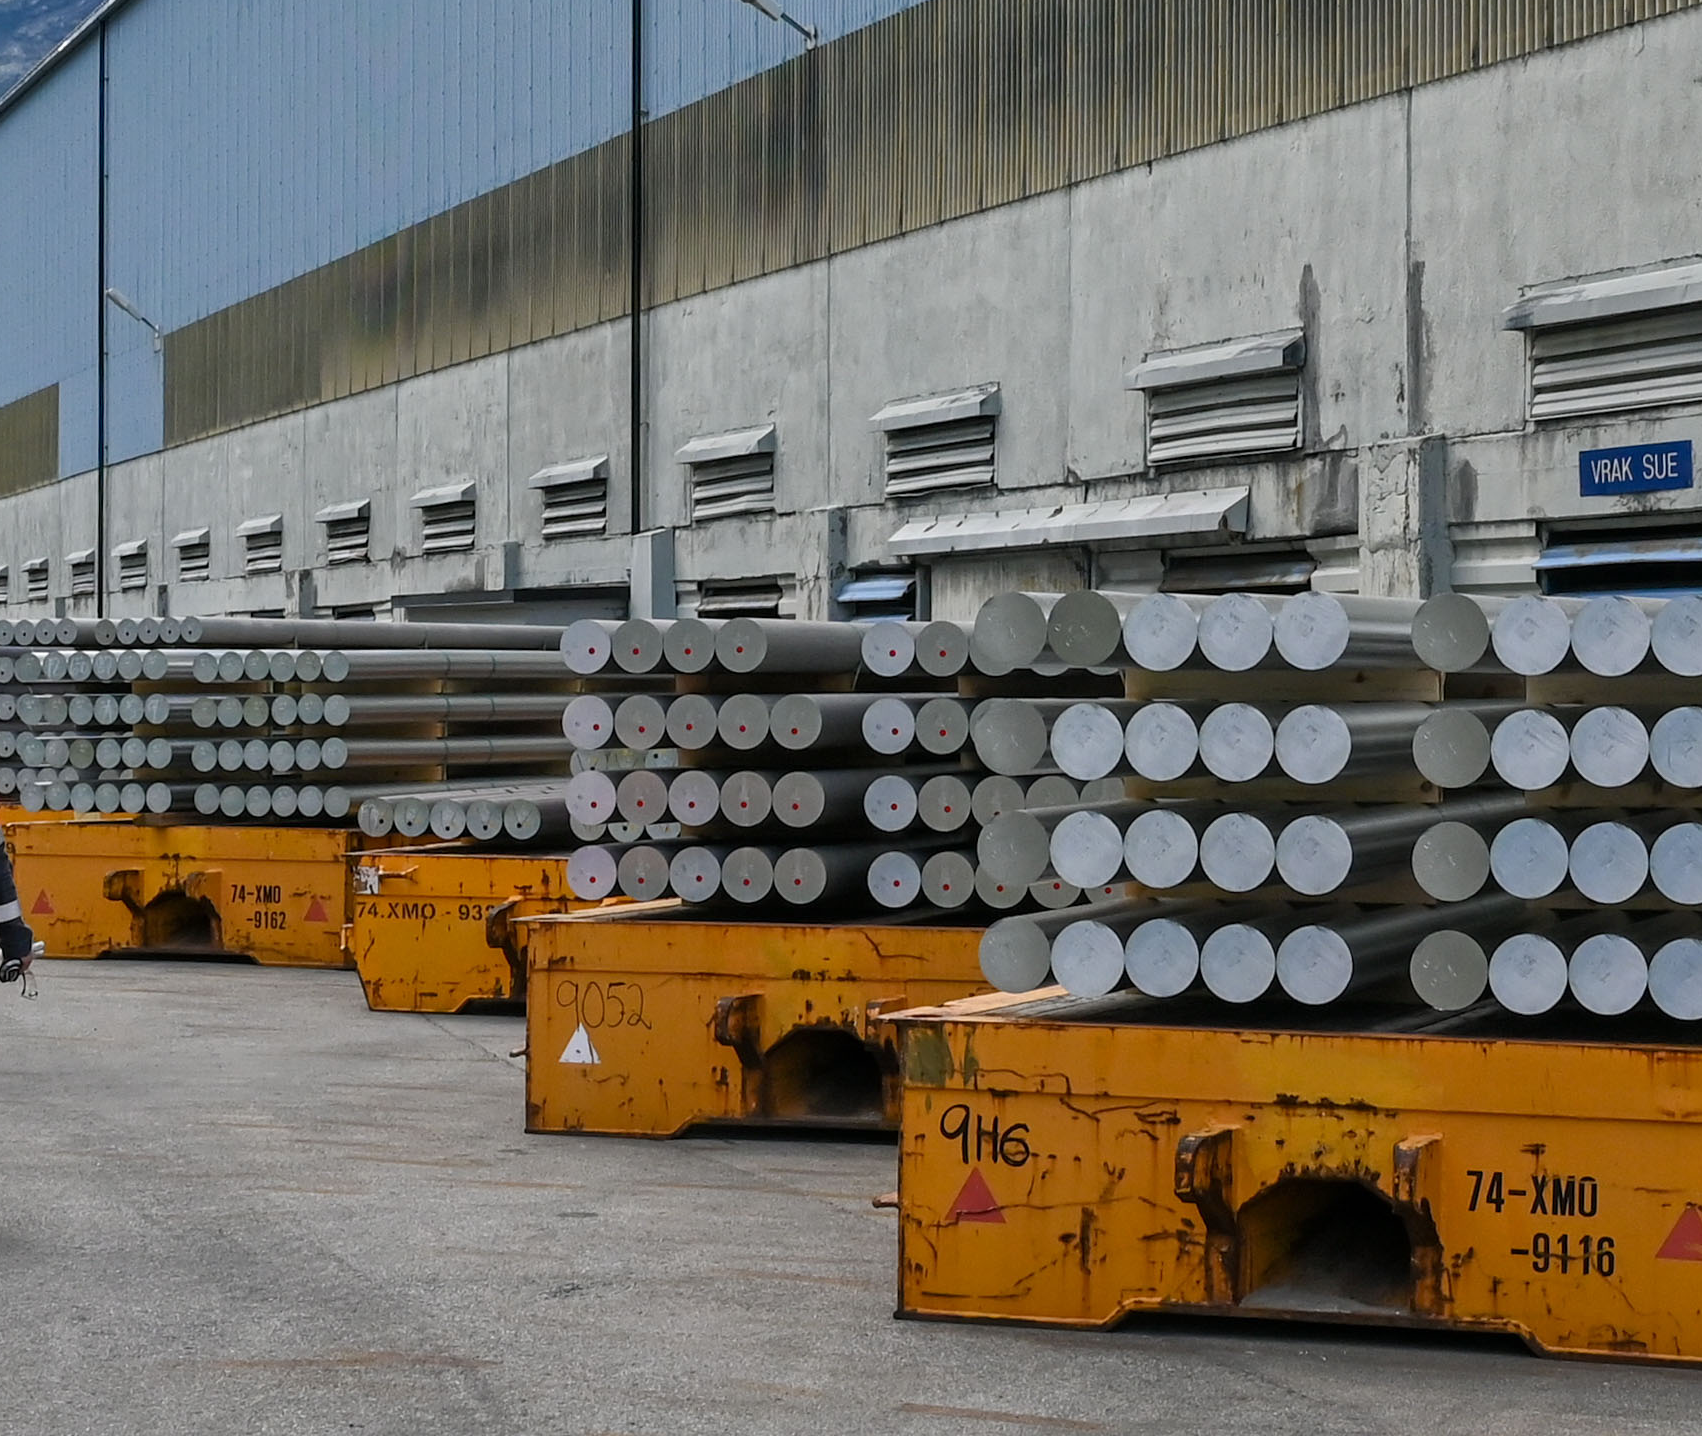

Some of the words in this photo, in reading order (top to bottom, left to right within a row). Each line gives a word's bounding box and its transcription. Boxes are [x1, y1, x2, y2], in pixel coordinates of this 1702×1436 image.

[1590, 455, 1634, 485] VRAK
[1642, 451, 1679, 481] SUE
[230, 884, 282, 905] 74-XMO
[356, 902, 436, 920] 74.XMO
[246, 910, 287, 930] -9162
[556, 979, 653, 1031] 9052
[1466, 1170, 1598, 1218] 74-XMO
[1510, 1232, 1616, 1278] -9116
